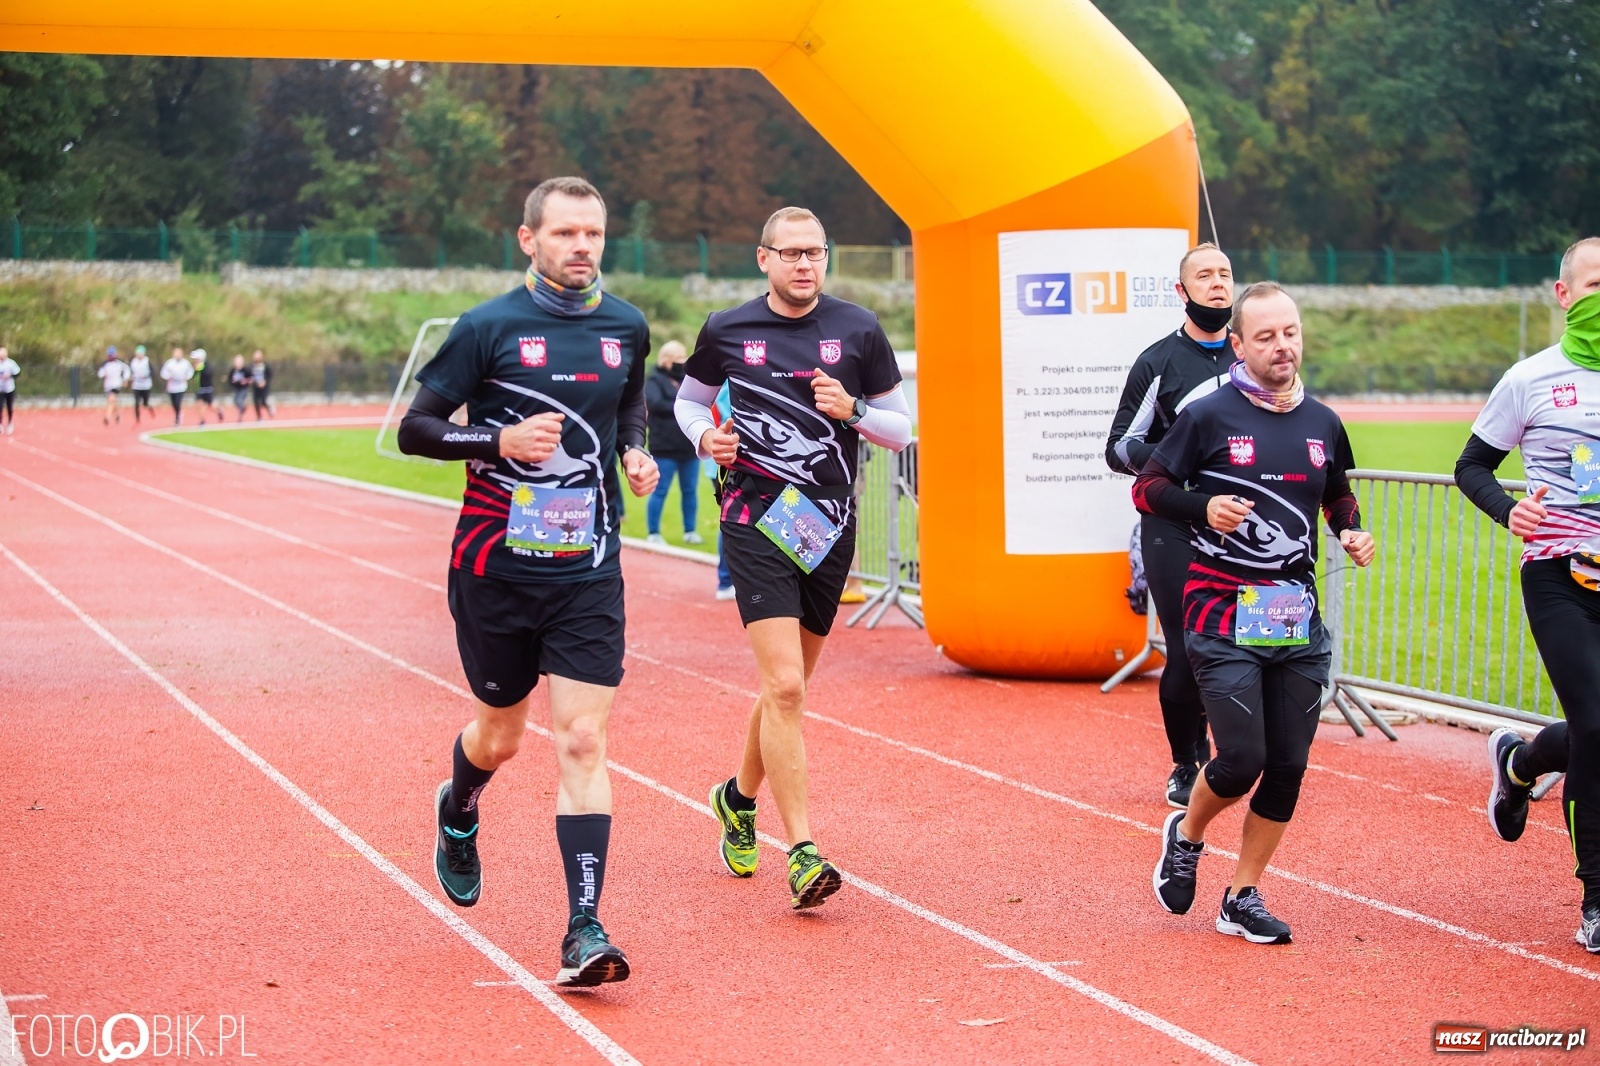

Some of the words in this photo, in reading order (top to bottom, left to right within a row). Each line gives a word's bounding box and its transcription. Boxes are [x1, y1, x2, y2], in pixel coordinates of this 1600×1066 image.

[1025, 281, 1065, 307] cz
[1085, 271, 1117, 314] pl
[1042, 365, 1075, 375] Projekt
[1086, 365, 1122, 373] numerze
[1024, 410, 1041, 419] jest
[1043, 408, 1116, 418] współfinansowa
[1042, 430, 1108, 440] Europejskiego
[1032, 452, 1095, 462] Regionalnego
[1026, 474, 1063, 482] budżetu
[1065, 474, 1103, 483] państwa
[522, 507, 540, 517] BIEG
[543, 510, 560, 519] DLA
[782, 505, 796, 519] BIEG
[795, 518, 807, 532] DLA
[560, 531, 587, 545] 227
[794, 543, 815, 563] 025
[1268, 607, 1281, 615] DLA
[1284, 626, 1304, 639] 218
